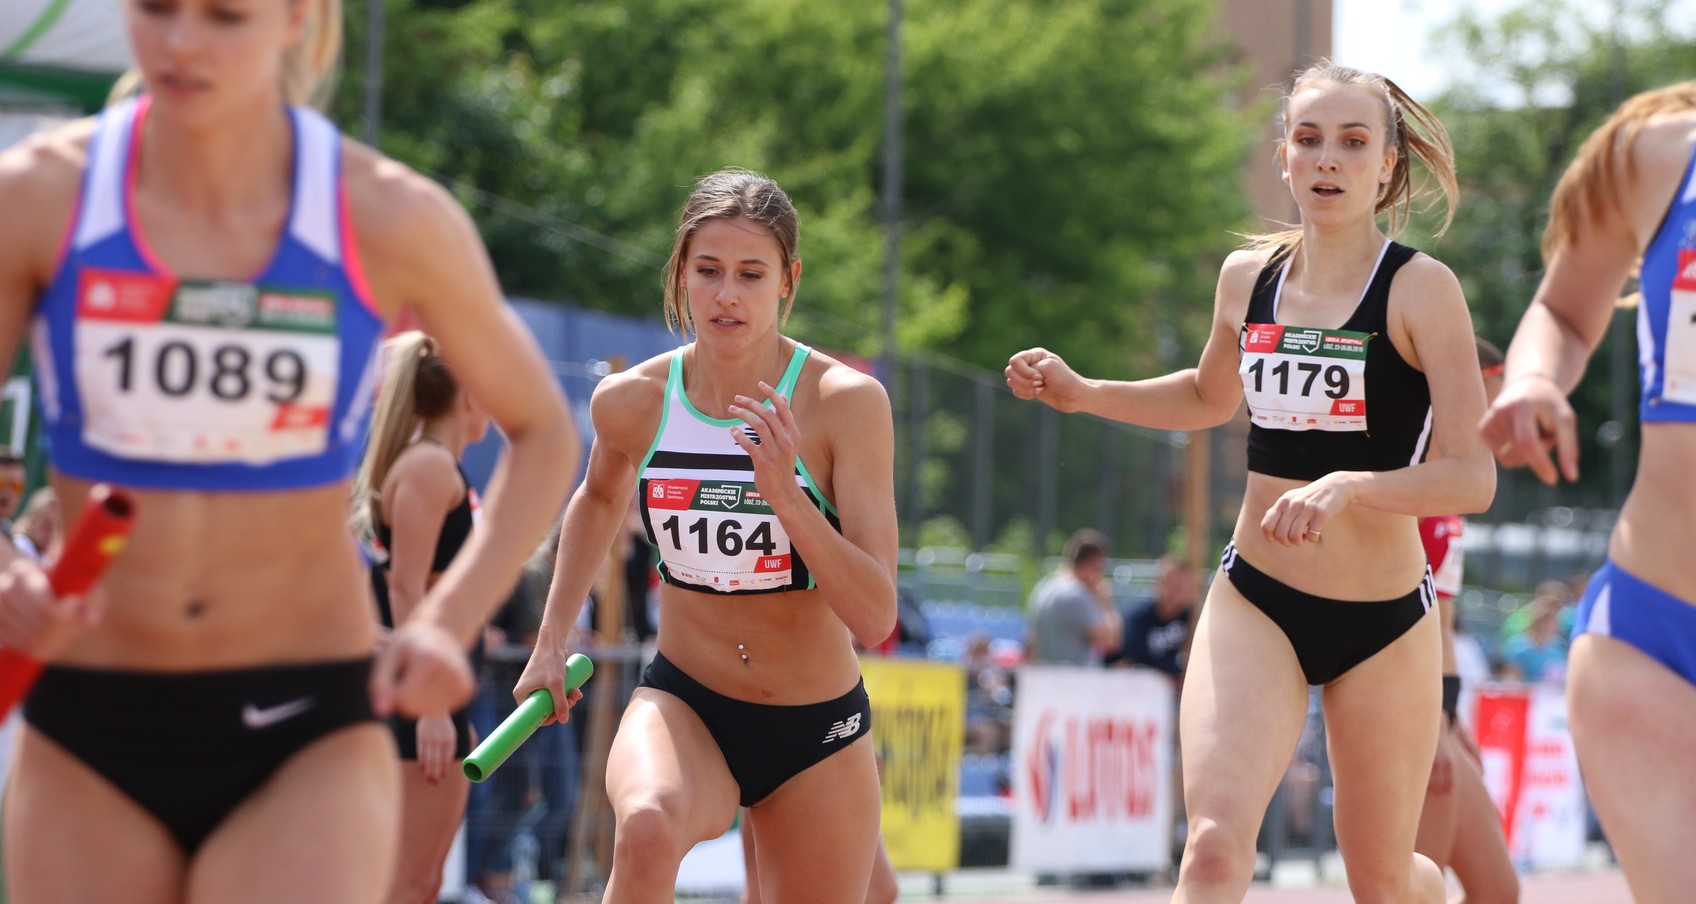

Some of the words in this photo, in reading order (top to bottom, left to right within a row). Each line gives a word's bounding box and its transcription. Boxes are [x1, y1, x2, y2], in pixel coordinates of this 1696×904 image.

[105, 334, 307, 405] 1089
[1248, 358, 1350, 400] 1179
[1339, 402, 1356, 413] UWF
[662, 515, 776, 557] 1164
[764, 559, 782, 569] UWF
